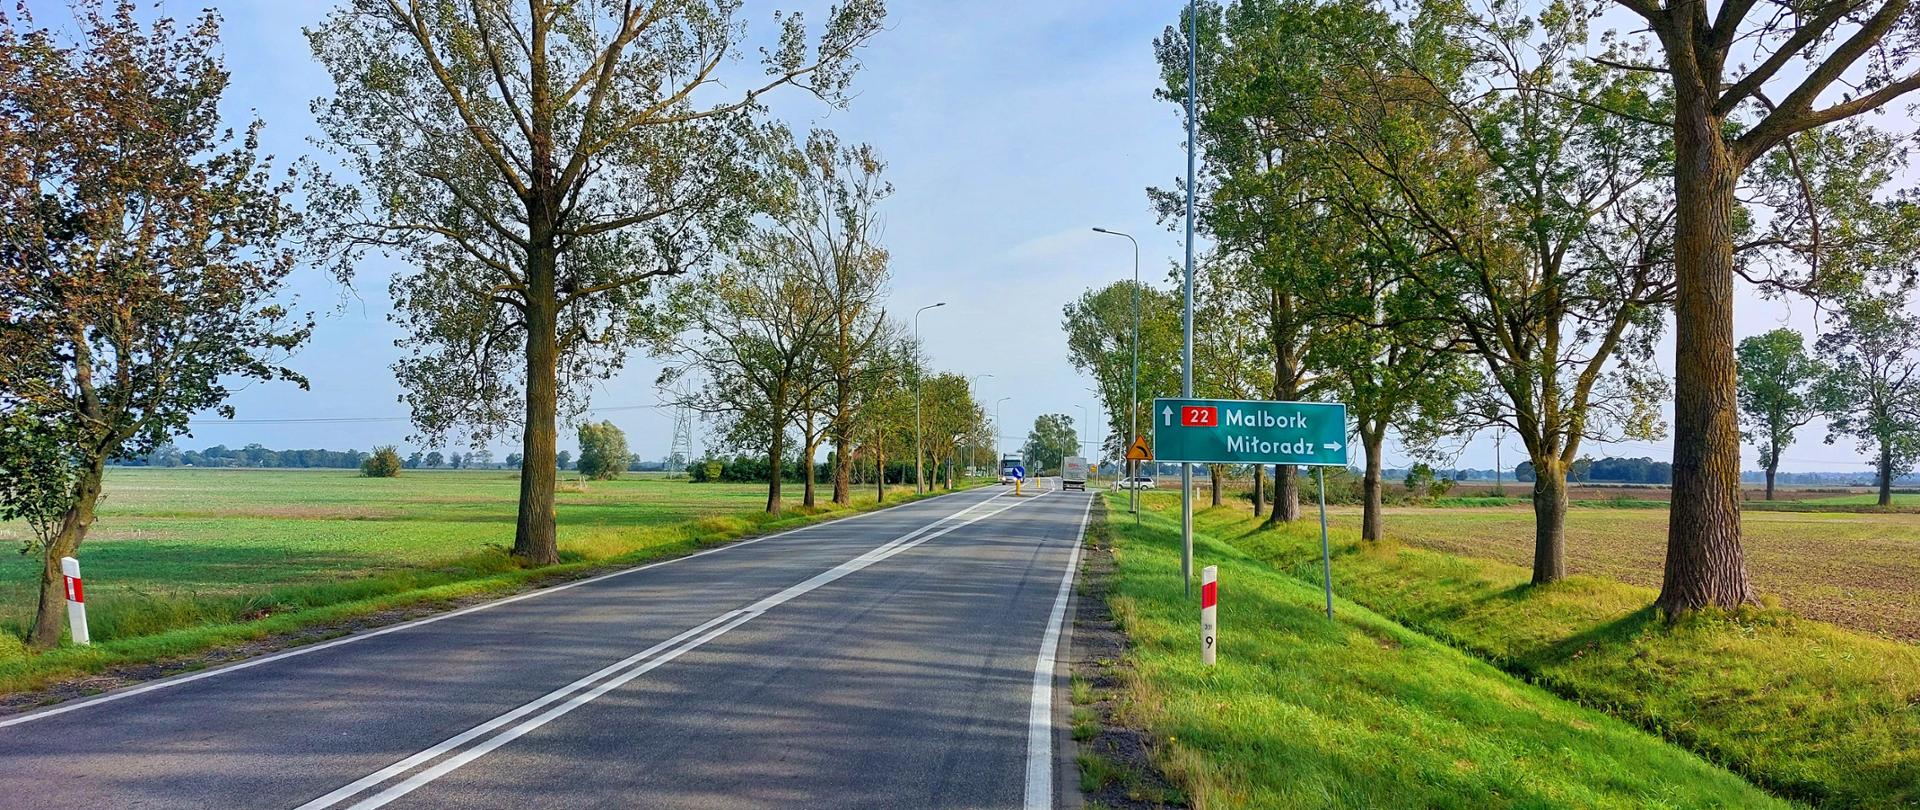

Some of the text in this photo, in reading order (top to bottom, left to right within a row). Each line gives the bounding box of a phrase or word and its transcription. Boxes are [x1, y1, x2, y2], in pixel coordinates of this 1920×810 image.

[1190, 409, 1308, 428] 22 Malbork
[1227, 436, 1315, 455] Miłoradz
[1205, 636, 1213, 649] 9
